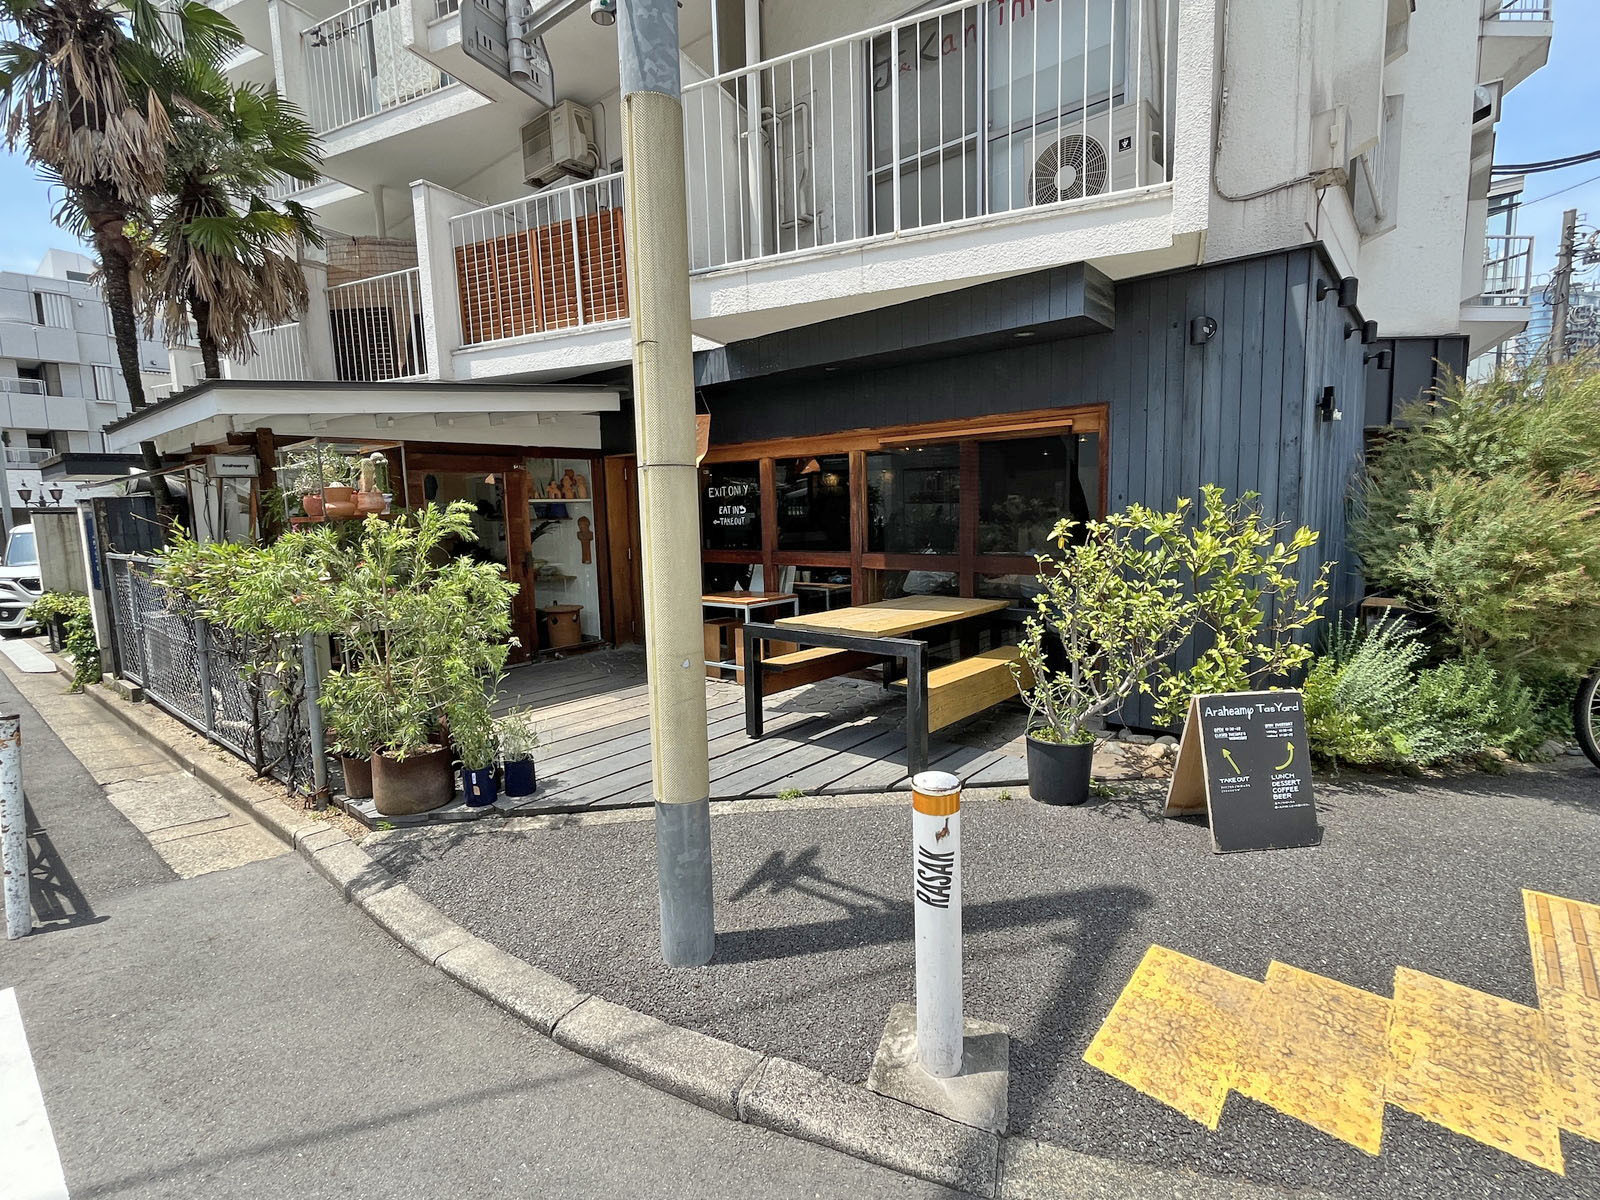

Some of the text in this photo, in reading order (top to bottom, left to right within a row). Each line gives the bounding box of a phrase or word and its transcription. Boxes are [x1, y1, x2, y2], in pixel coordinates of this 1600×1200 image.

[708, 486, 727, 498] EXIT
[718, 506, 731, 515] EAT
[1271, 779, 1301, 787] DESSERT
[1272, 785, 1299, 793] COFFEE
[1272, 792, 1294, 800] BEER
[916, 845, 955, 909] RASAK
